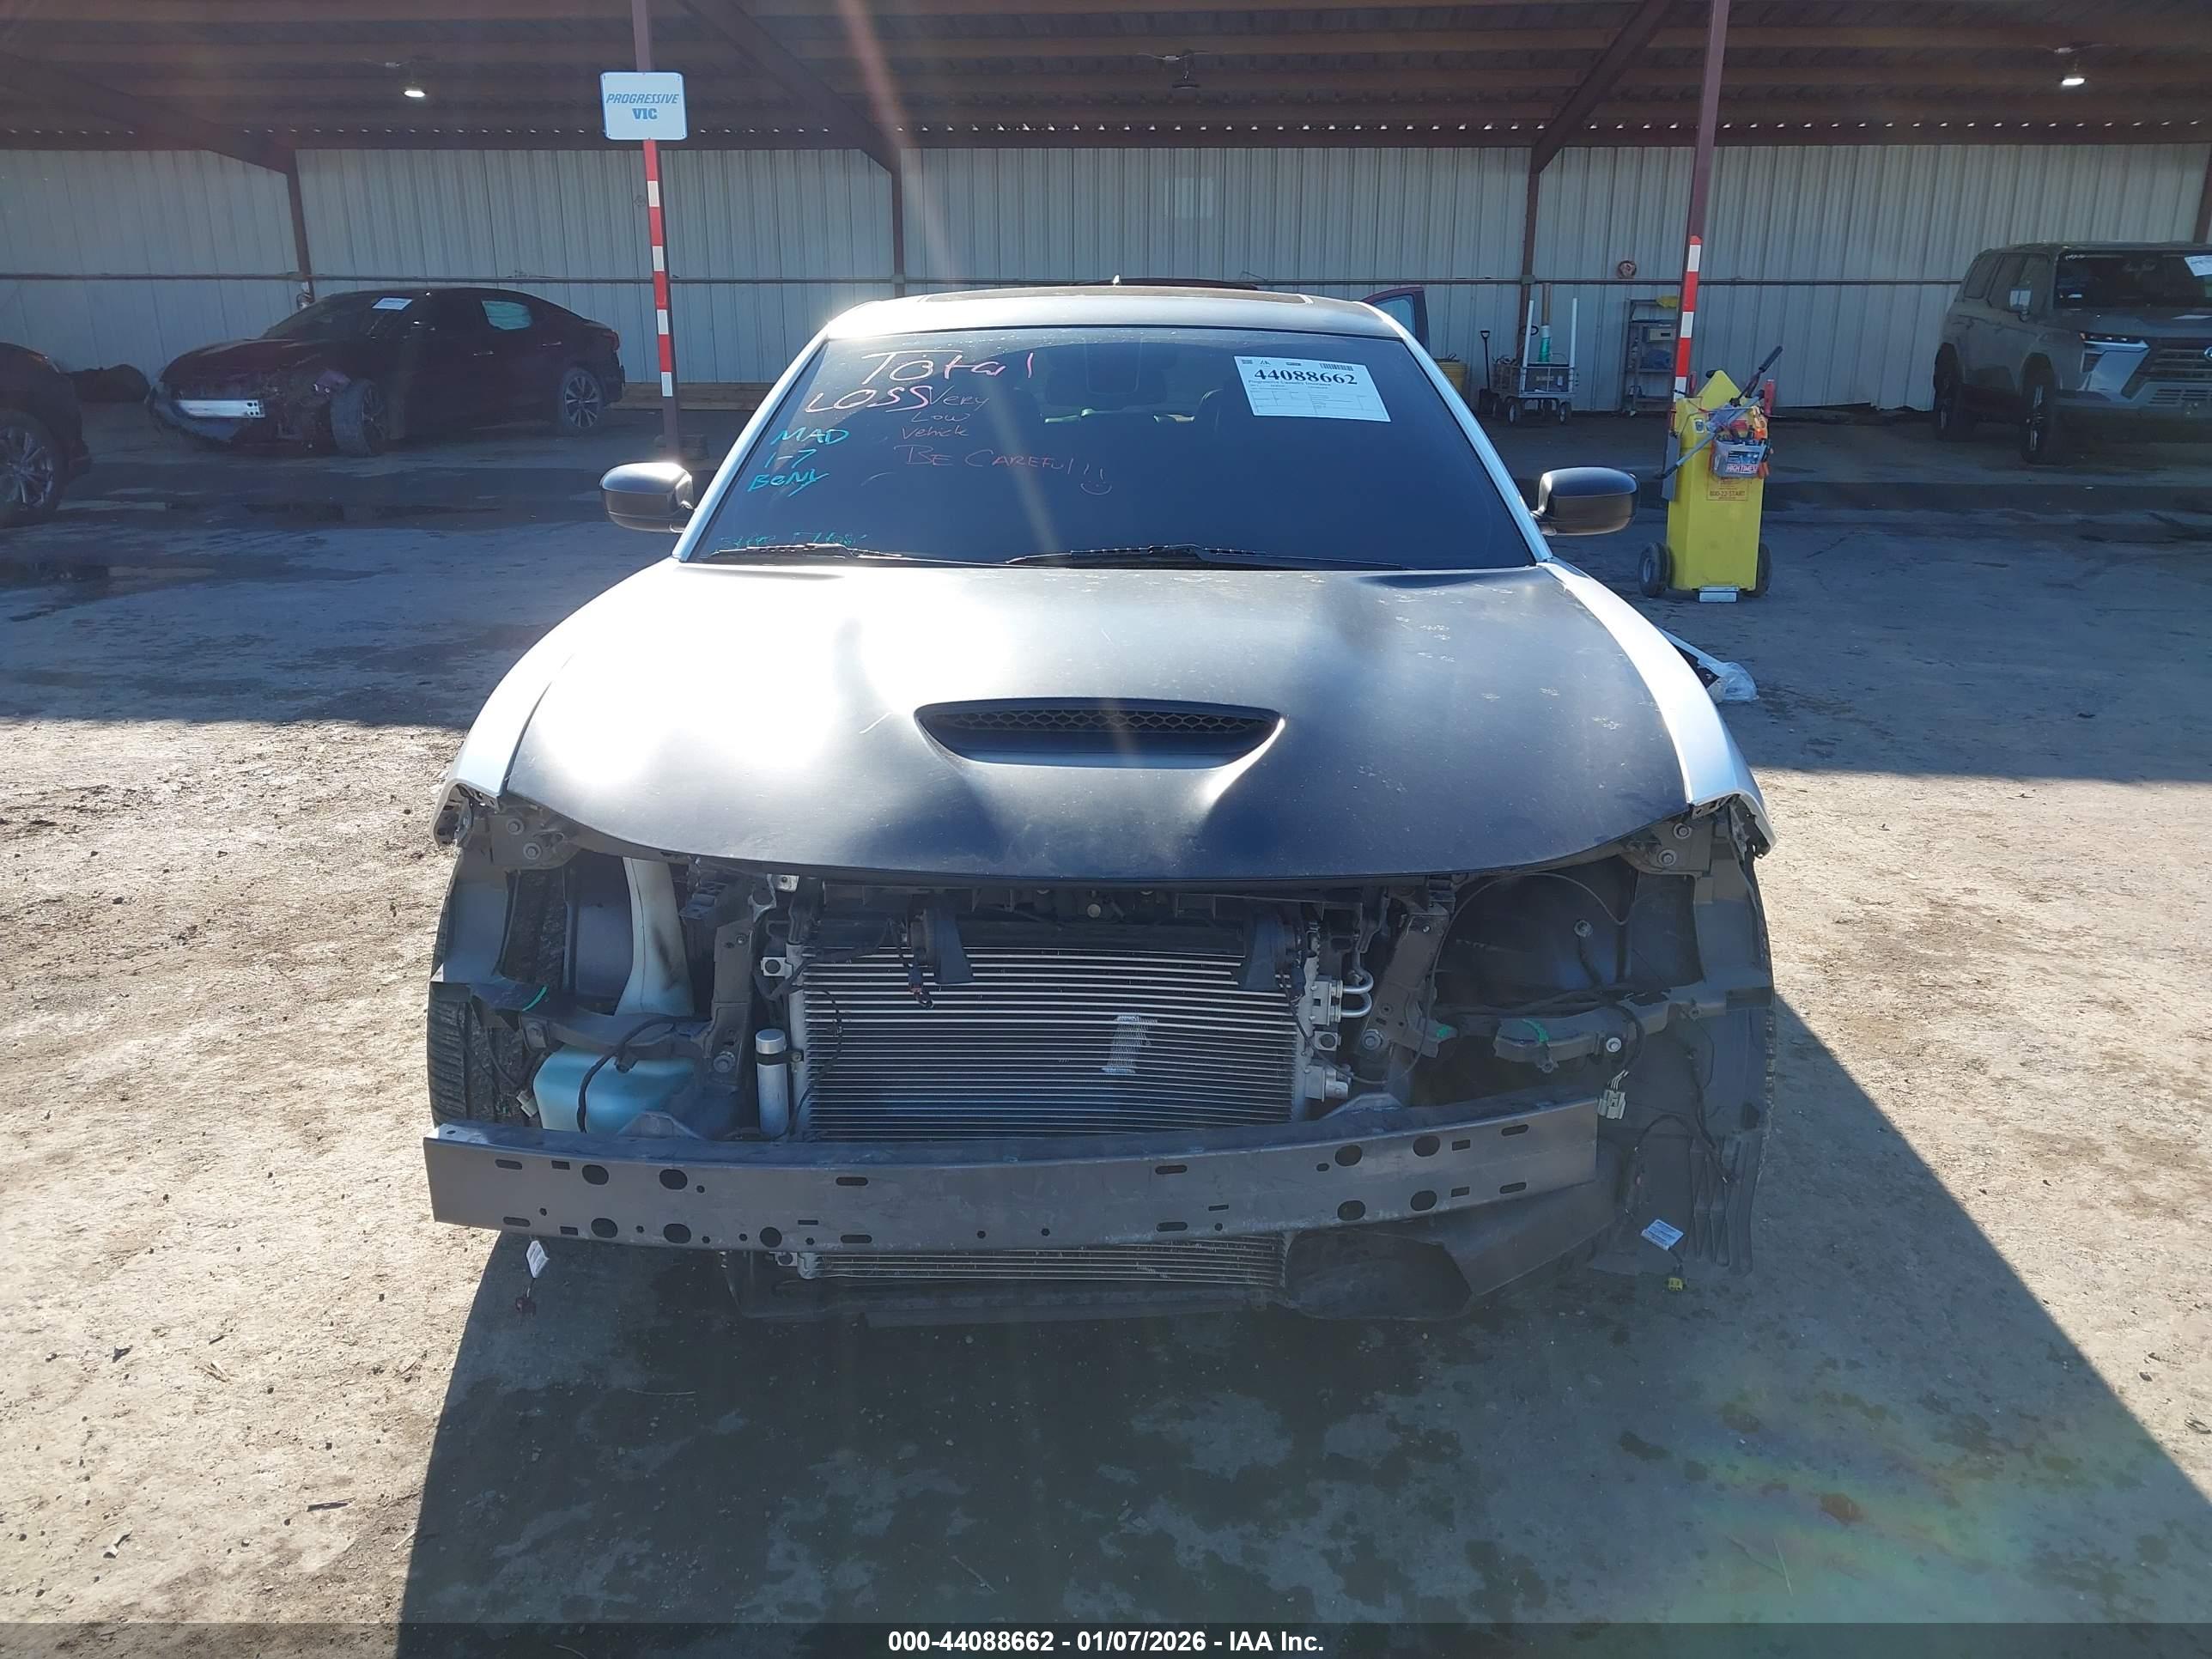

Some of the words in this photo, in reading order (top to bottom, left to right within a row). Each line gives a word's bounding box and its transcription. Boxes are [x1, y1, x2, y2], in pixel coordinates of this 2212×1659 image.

[605, 94, 679, 104] PROGRESSIVE
[632, 107, 658, 119] VIC
[1254, 369, 1358, 385] 44088662
[805, 386, 934, 413] LOSS
[769, 427, 850, 446] MAD
[764, 448, 817, 469] 1-7
[893, 444, 954, 466] BE
